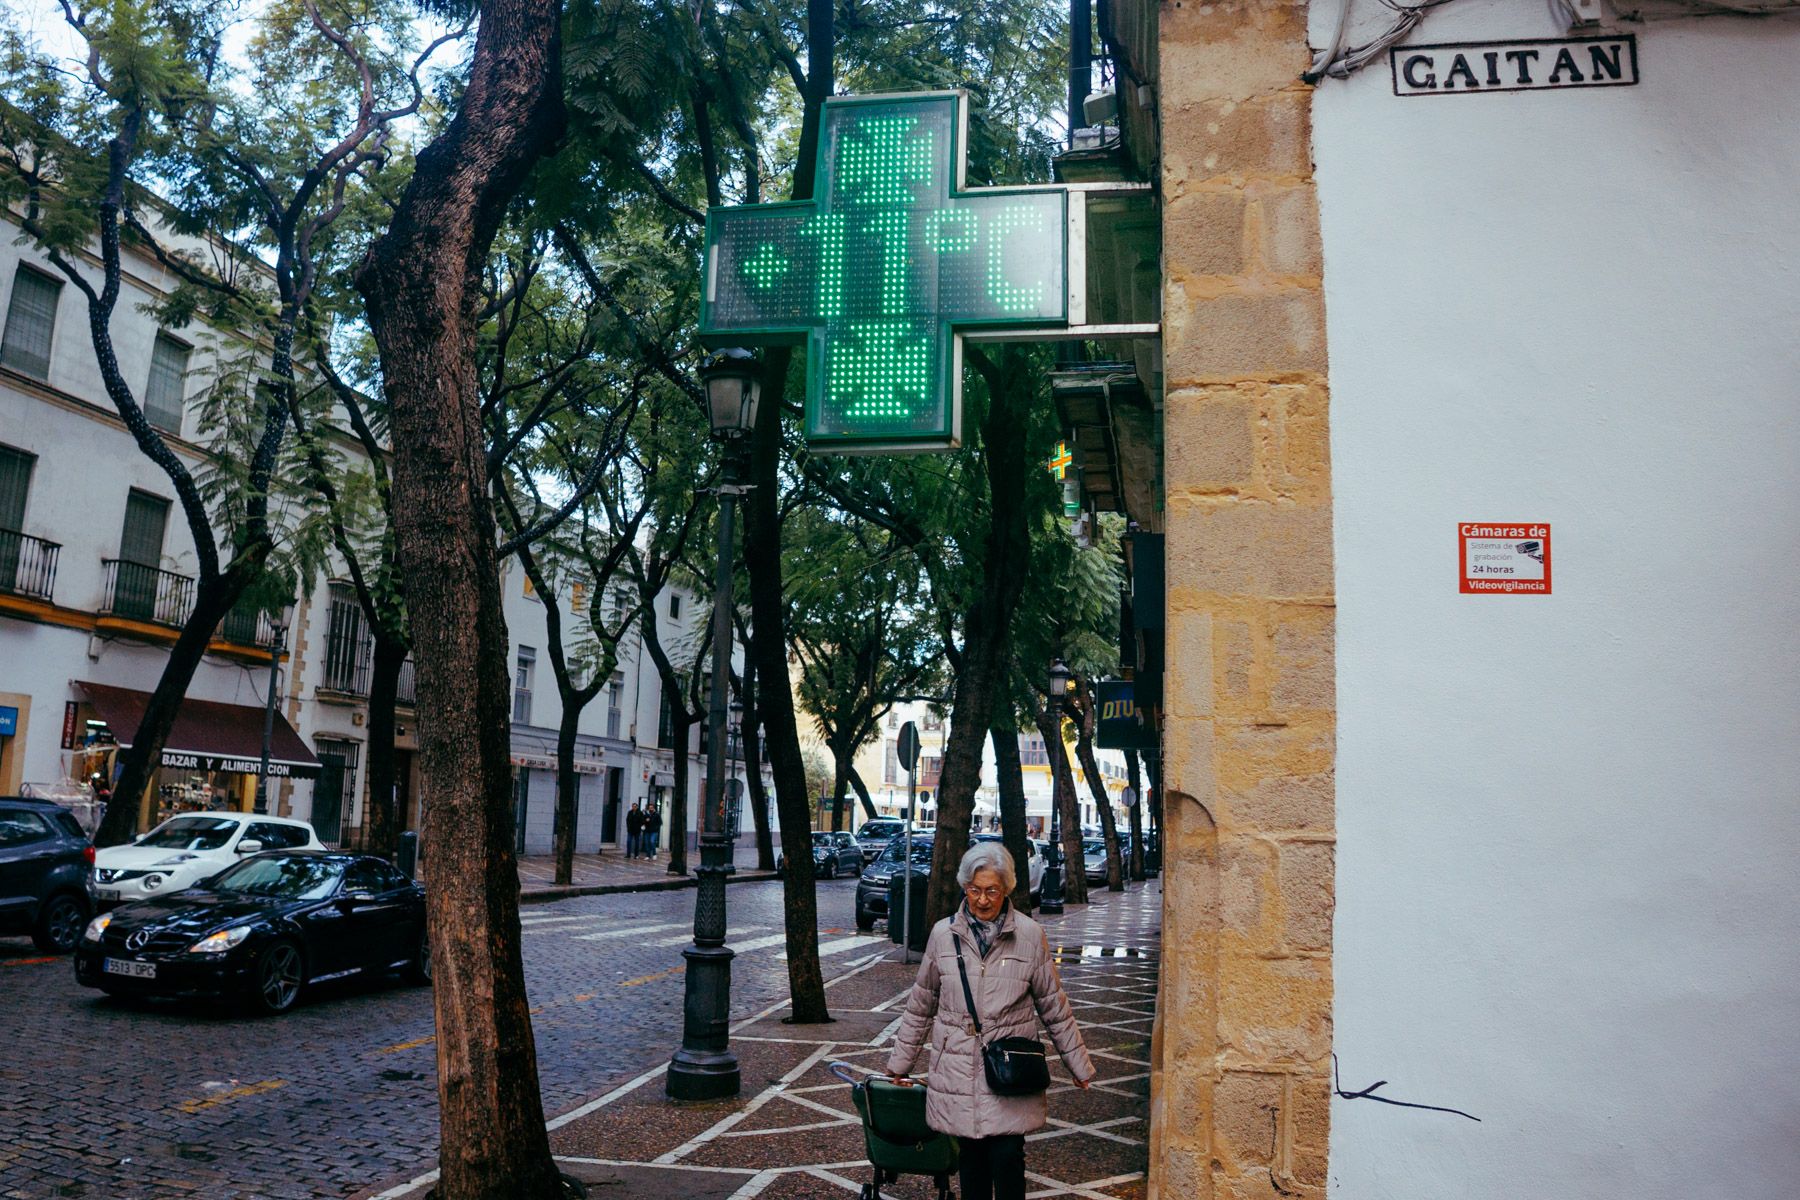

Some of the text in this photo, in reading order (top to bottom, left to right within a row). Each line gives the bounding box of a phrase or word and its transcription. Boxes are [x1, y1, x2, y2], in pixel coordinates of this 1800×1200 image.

[1403, 45, 1621, 89] GAITAN
[1462, 525, 1547, 537] Cámaras de
[1474, 554, 1513, 562] grabación
[1472, 565, 1515, 574] 24 horas
[1469, 581, 1545, 592] Videovigilancia
[162, 754, 290, 776] BAZAR Y ALIMENTCION
